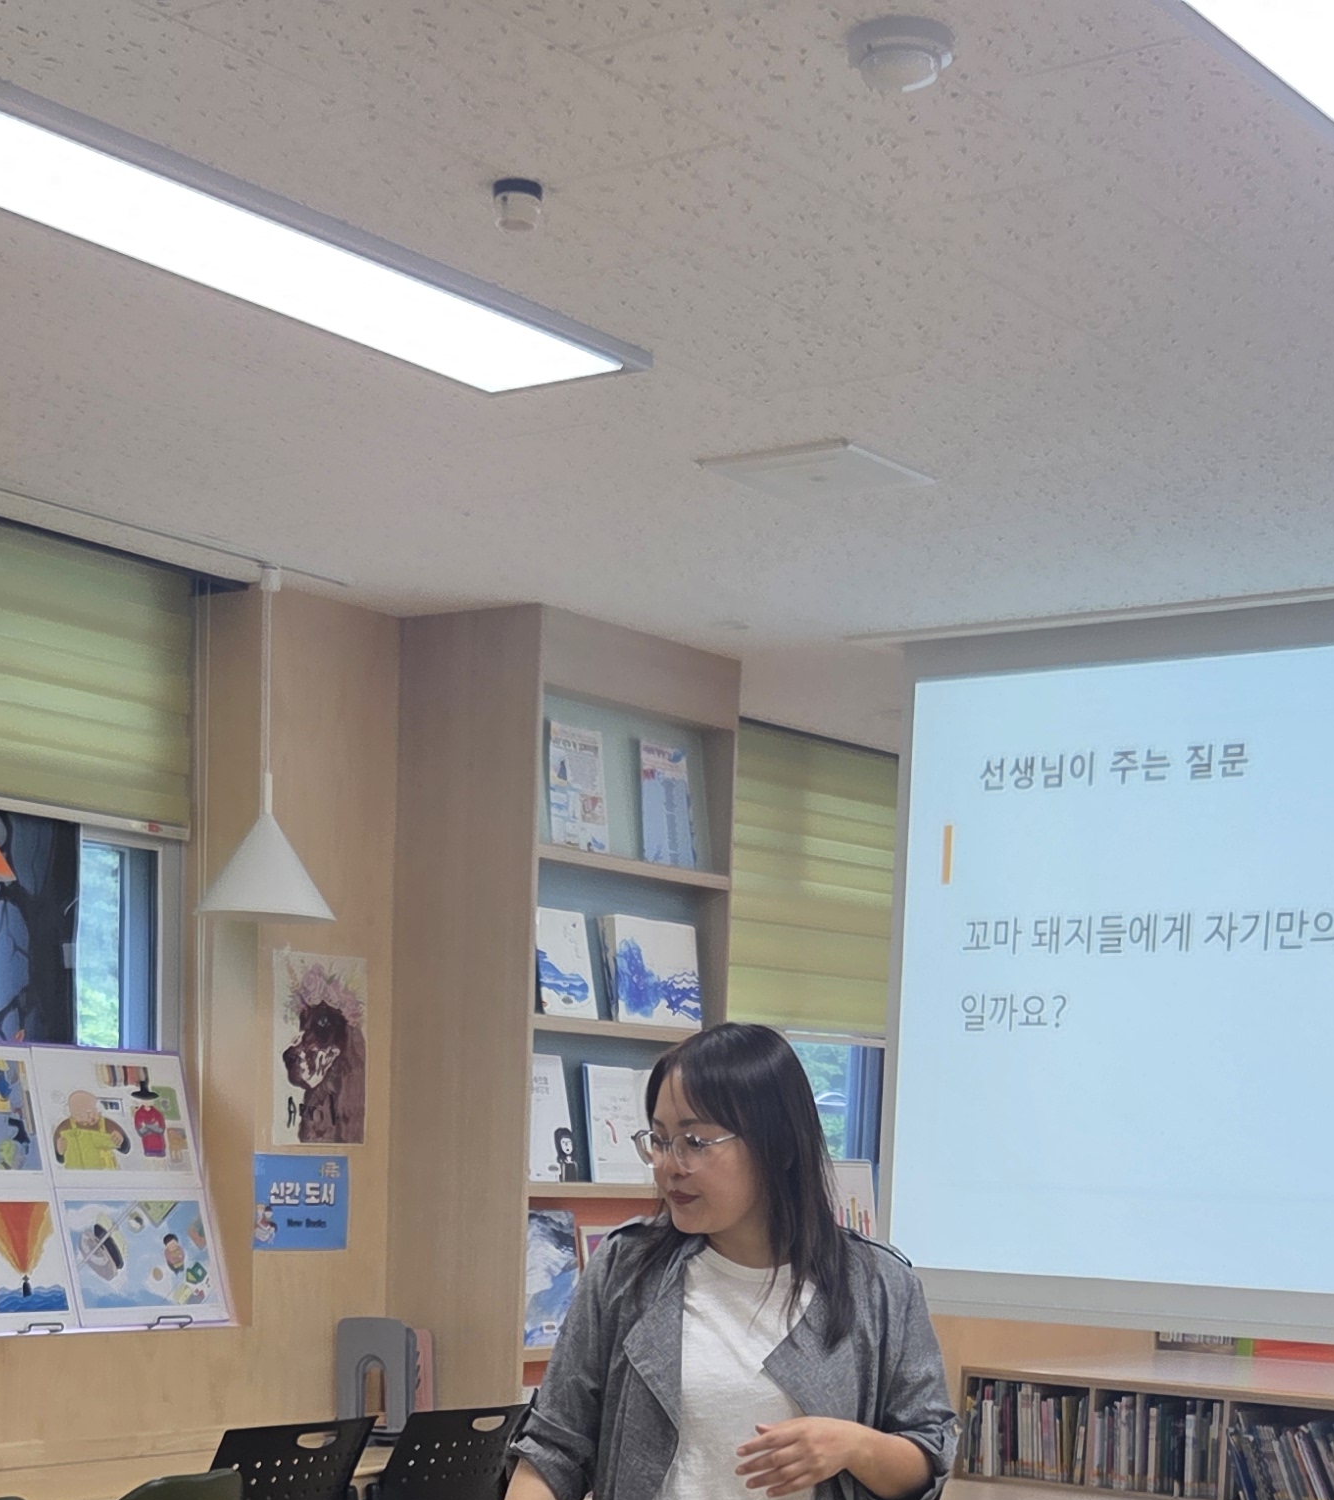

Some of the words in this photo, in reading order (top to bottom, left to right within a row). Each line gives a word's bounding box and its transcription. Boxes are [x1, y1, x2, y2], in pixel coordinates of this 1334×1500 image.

[979, 750, 1096, 791] 선생님이
[1109, 748, 1172, 785] 주는
[1185, 742, 1249, 780] 질문
[961, 915, 1023, 956] 꼬마
[1029, 910, 1192, 956] 돼지들에게
[960, 992, 1068, 1032] 일까요?
[269, 1181, 301, 1206] 신간
[304, 1181, 336, 1207] 도서
